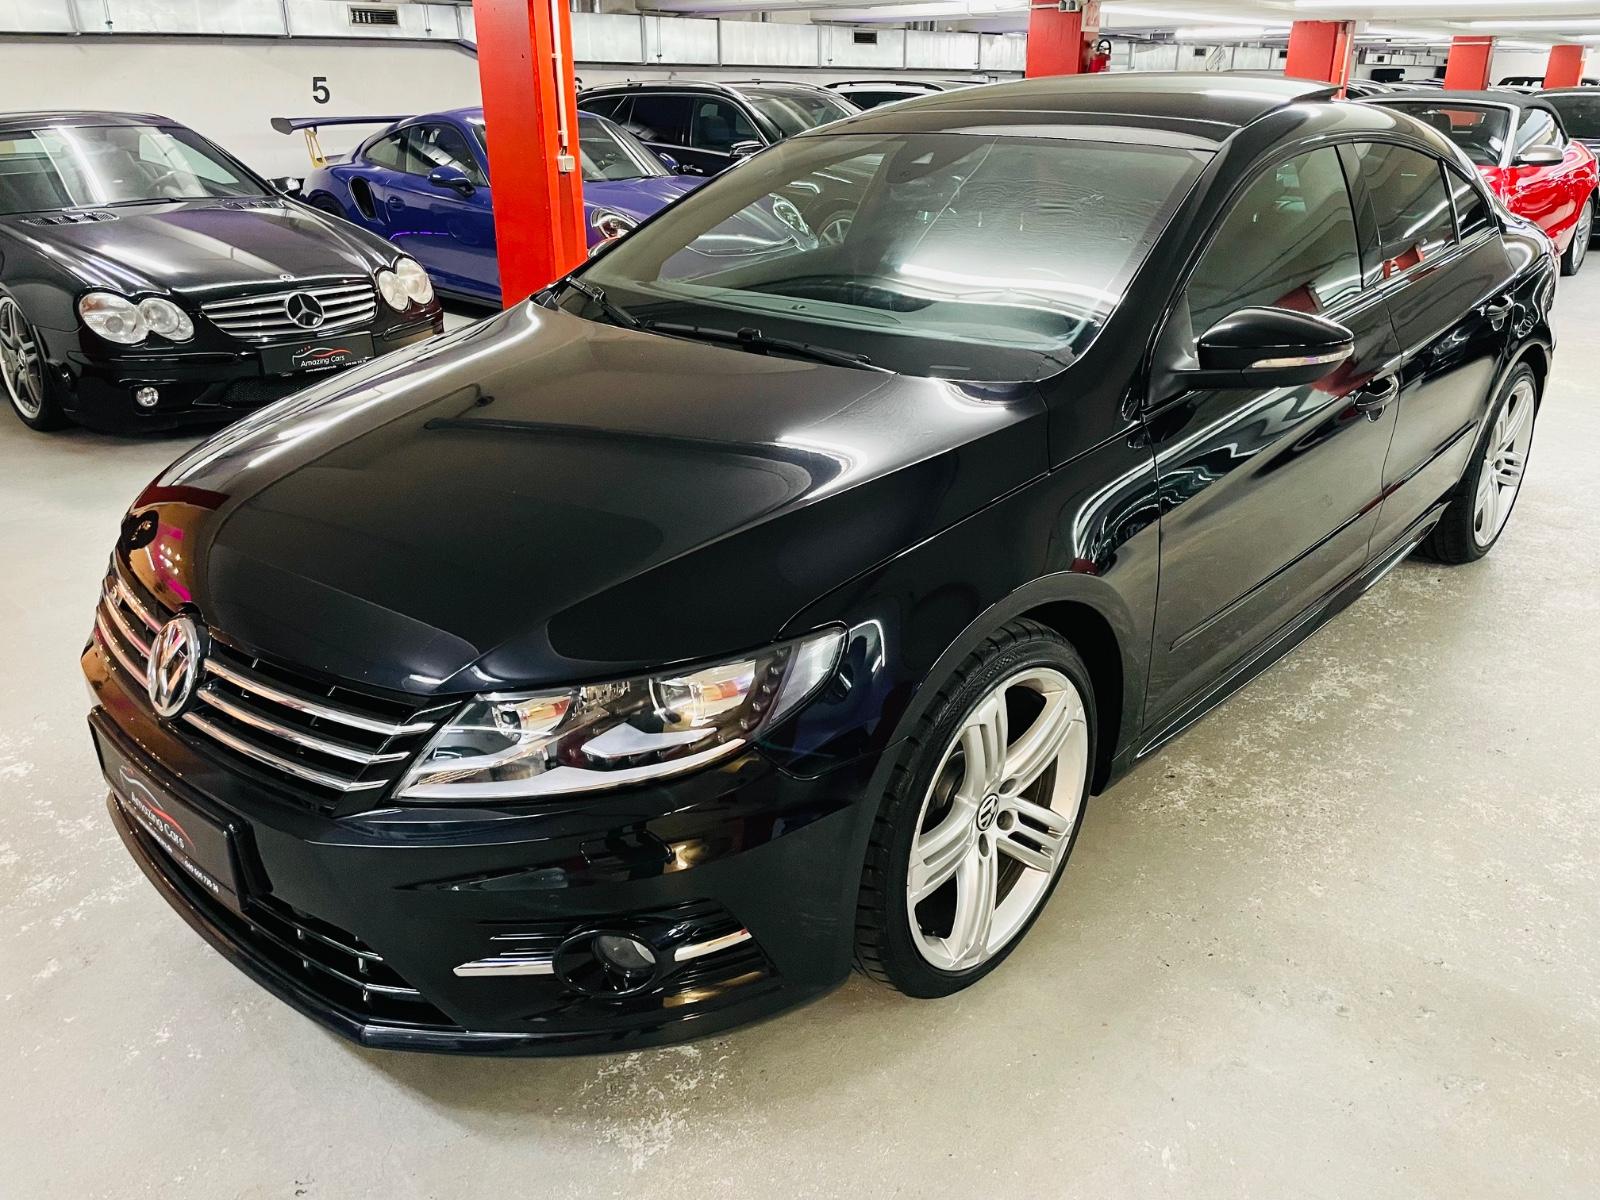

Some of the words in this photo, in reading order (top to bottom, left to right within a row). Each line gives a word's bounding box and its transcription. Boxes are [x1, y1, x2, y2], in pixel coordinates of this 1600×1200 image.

[312, 76, 330, 104] 5
[300, 357, 330, 368] Amazing
[331, 354, 345, 363] Cars
[131, 791, 164, 832] Amazing
[164, 823, 185, 849] Cars
